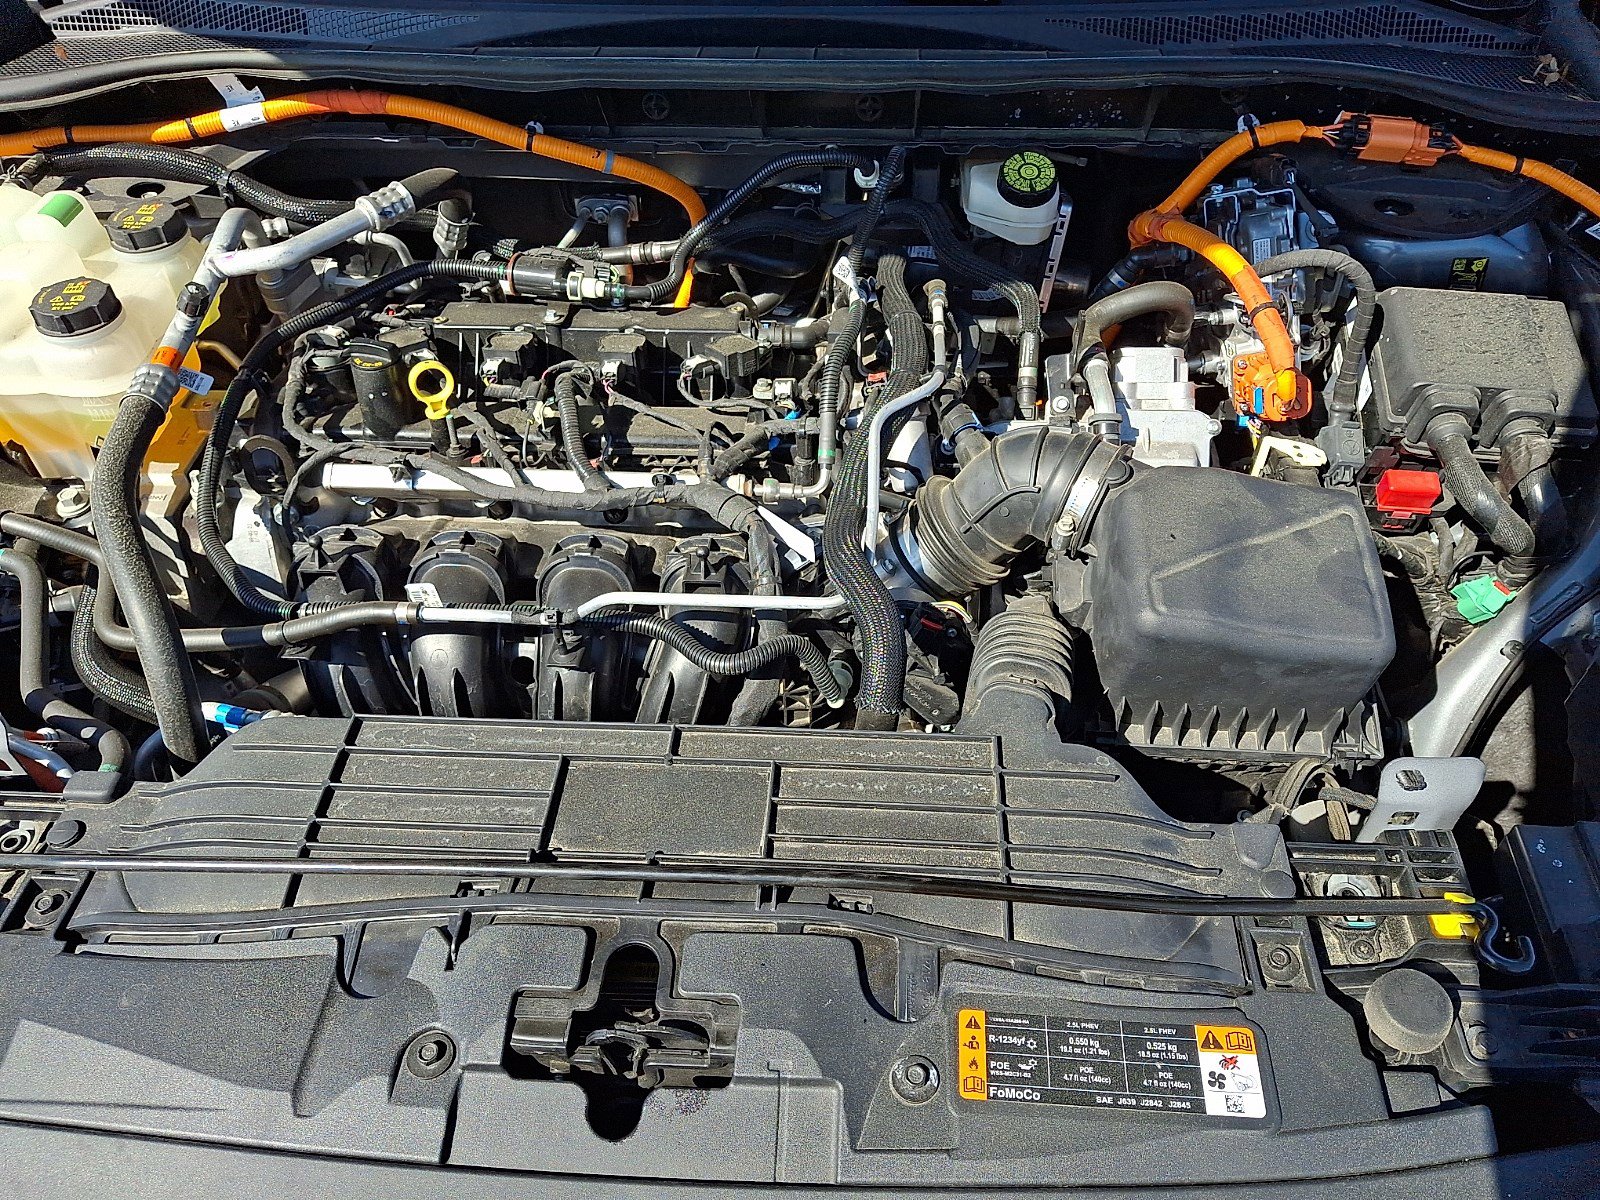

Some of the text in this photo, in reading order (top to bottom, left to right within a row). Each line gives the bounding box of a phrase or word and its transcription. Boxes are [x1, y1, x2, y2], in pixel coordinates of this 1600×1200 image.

[989, 1034, 1026, 1047] R-1234yf
[1069, 1036, 1100, 1048] 0.550 kg
[1146, 1041, 1178, 1052] 0.525 kg
[990, 1061, 1011, 1070] POE
[1080, 1066, 1095, 1074] POE
[1158, 1071, 1174, 1080] POE
[989, 1086, 1041, 1101] FoMoCo
[1096, 1096, 1114, 1105] SAE
